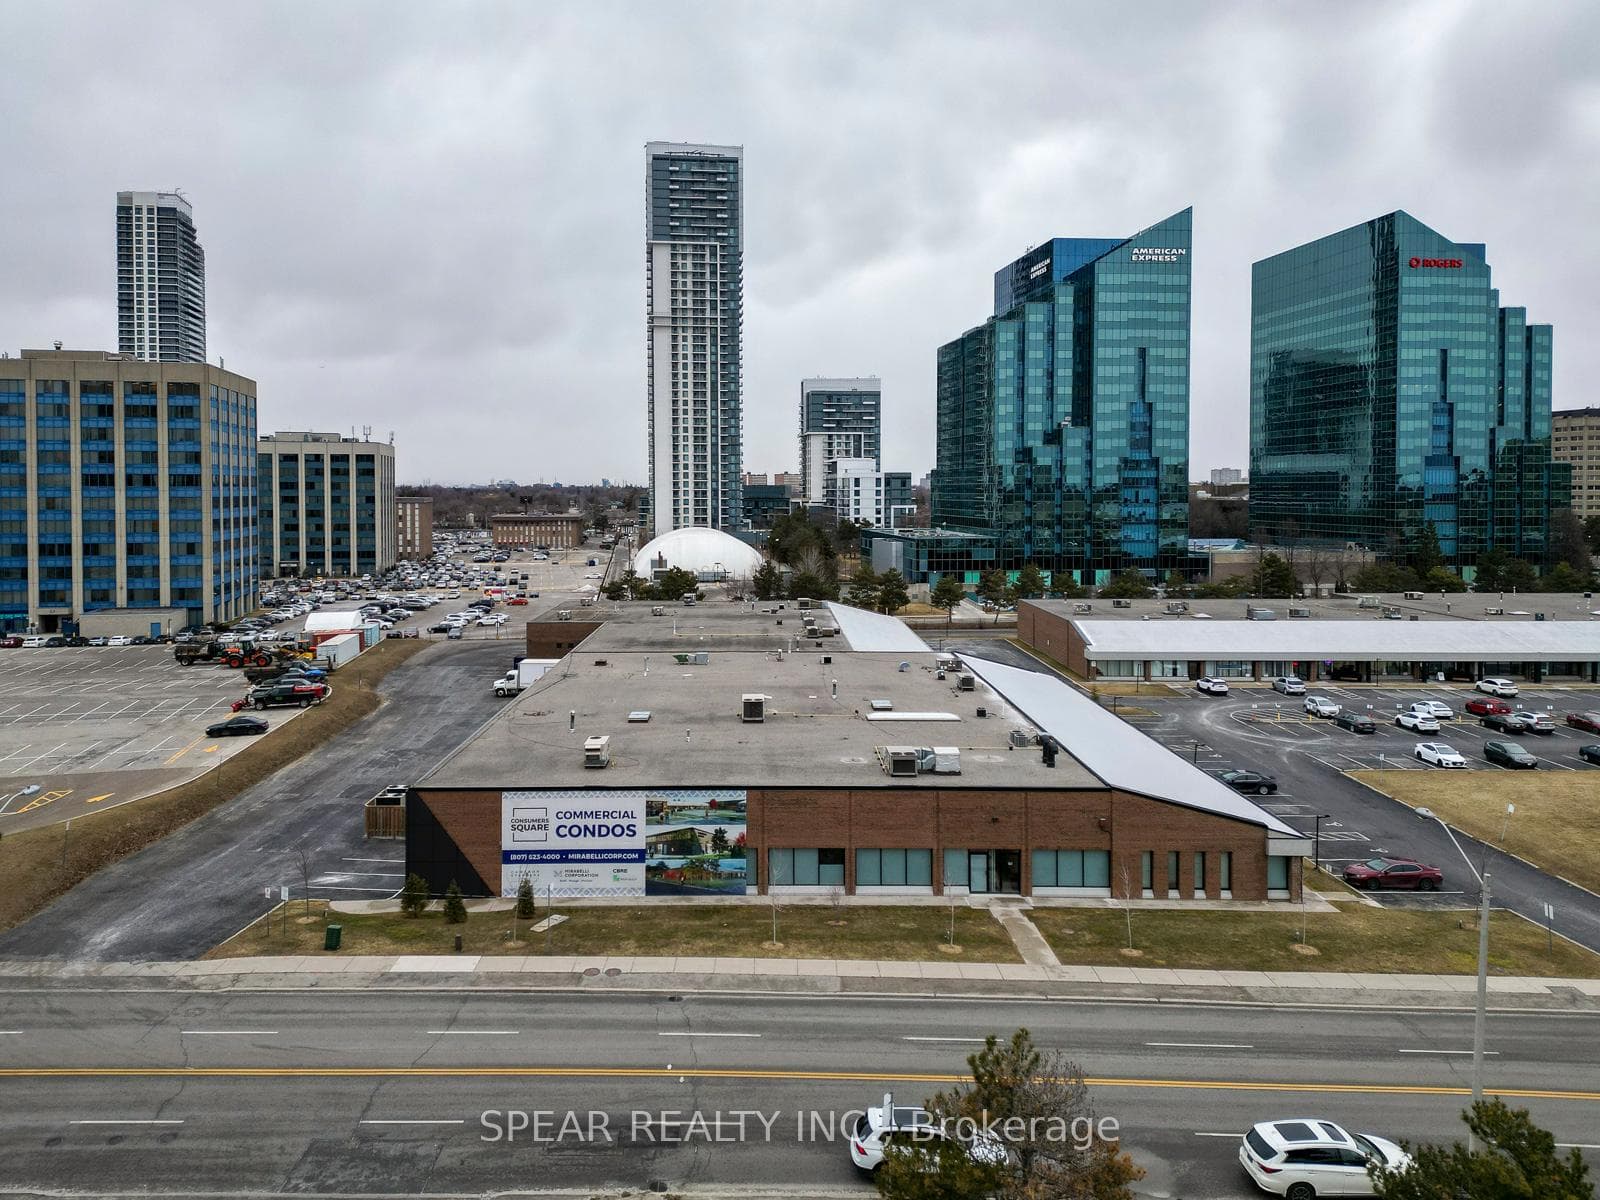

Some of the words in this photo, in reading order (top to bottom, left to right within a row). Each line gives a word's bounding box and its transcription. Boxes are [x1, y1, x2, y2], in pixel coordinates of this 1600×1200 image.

[1030, 257, 1051, 273] AMERICAN
[1423, 258, 1463, 268] ROGERS
[555, 810, 637, 820] COMMERCIAL
[510, 823, 549, 832] SQUARE
[555, 824, 637, 838] CONDOS
